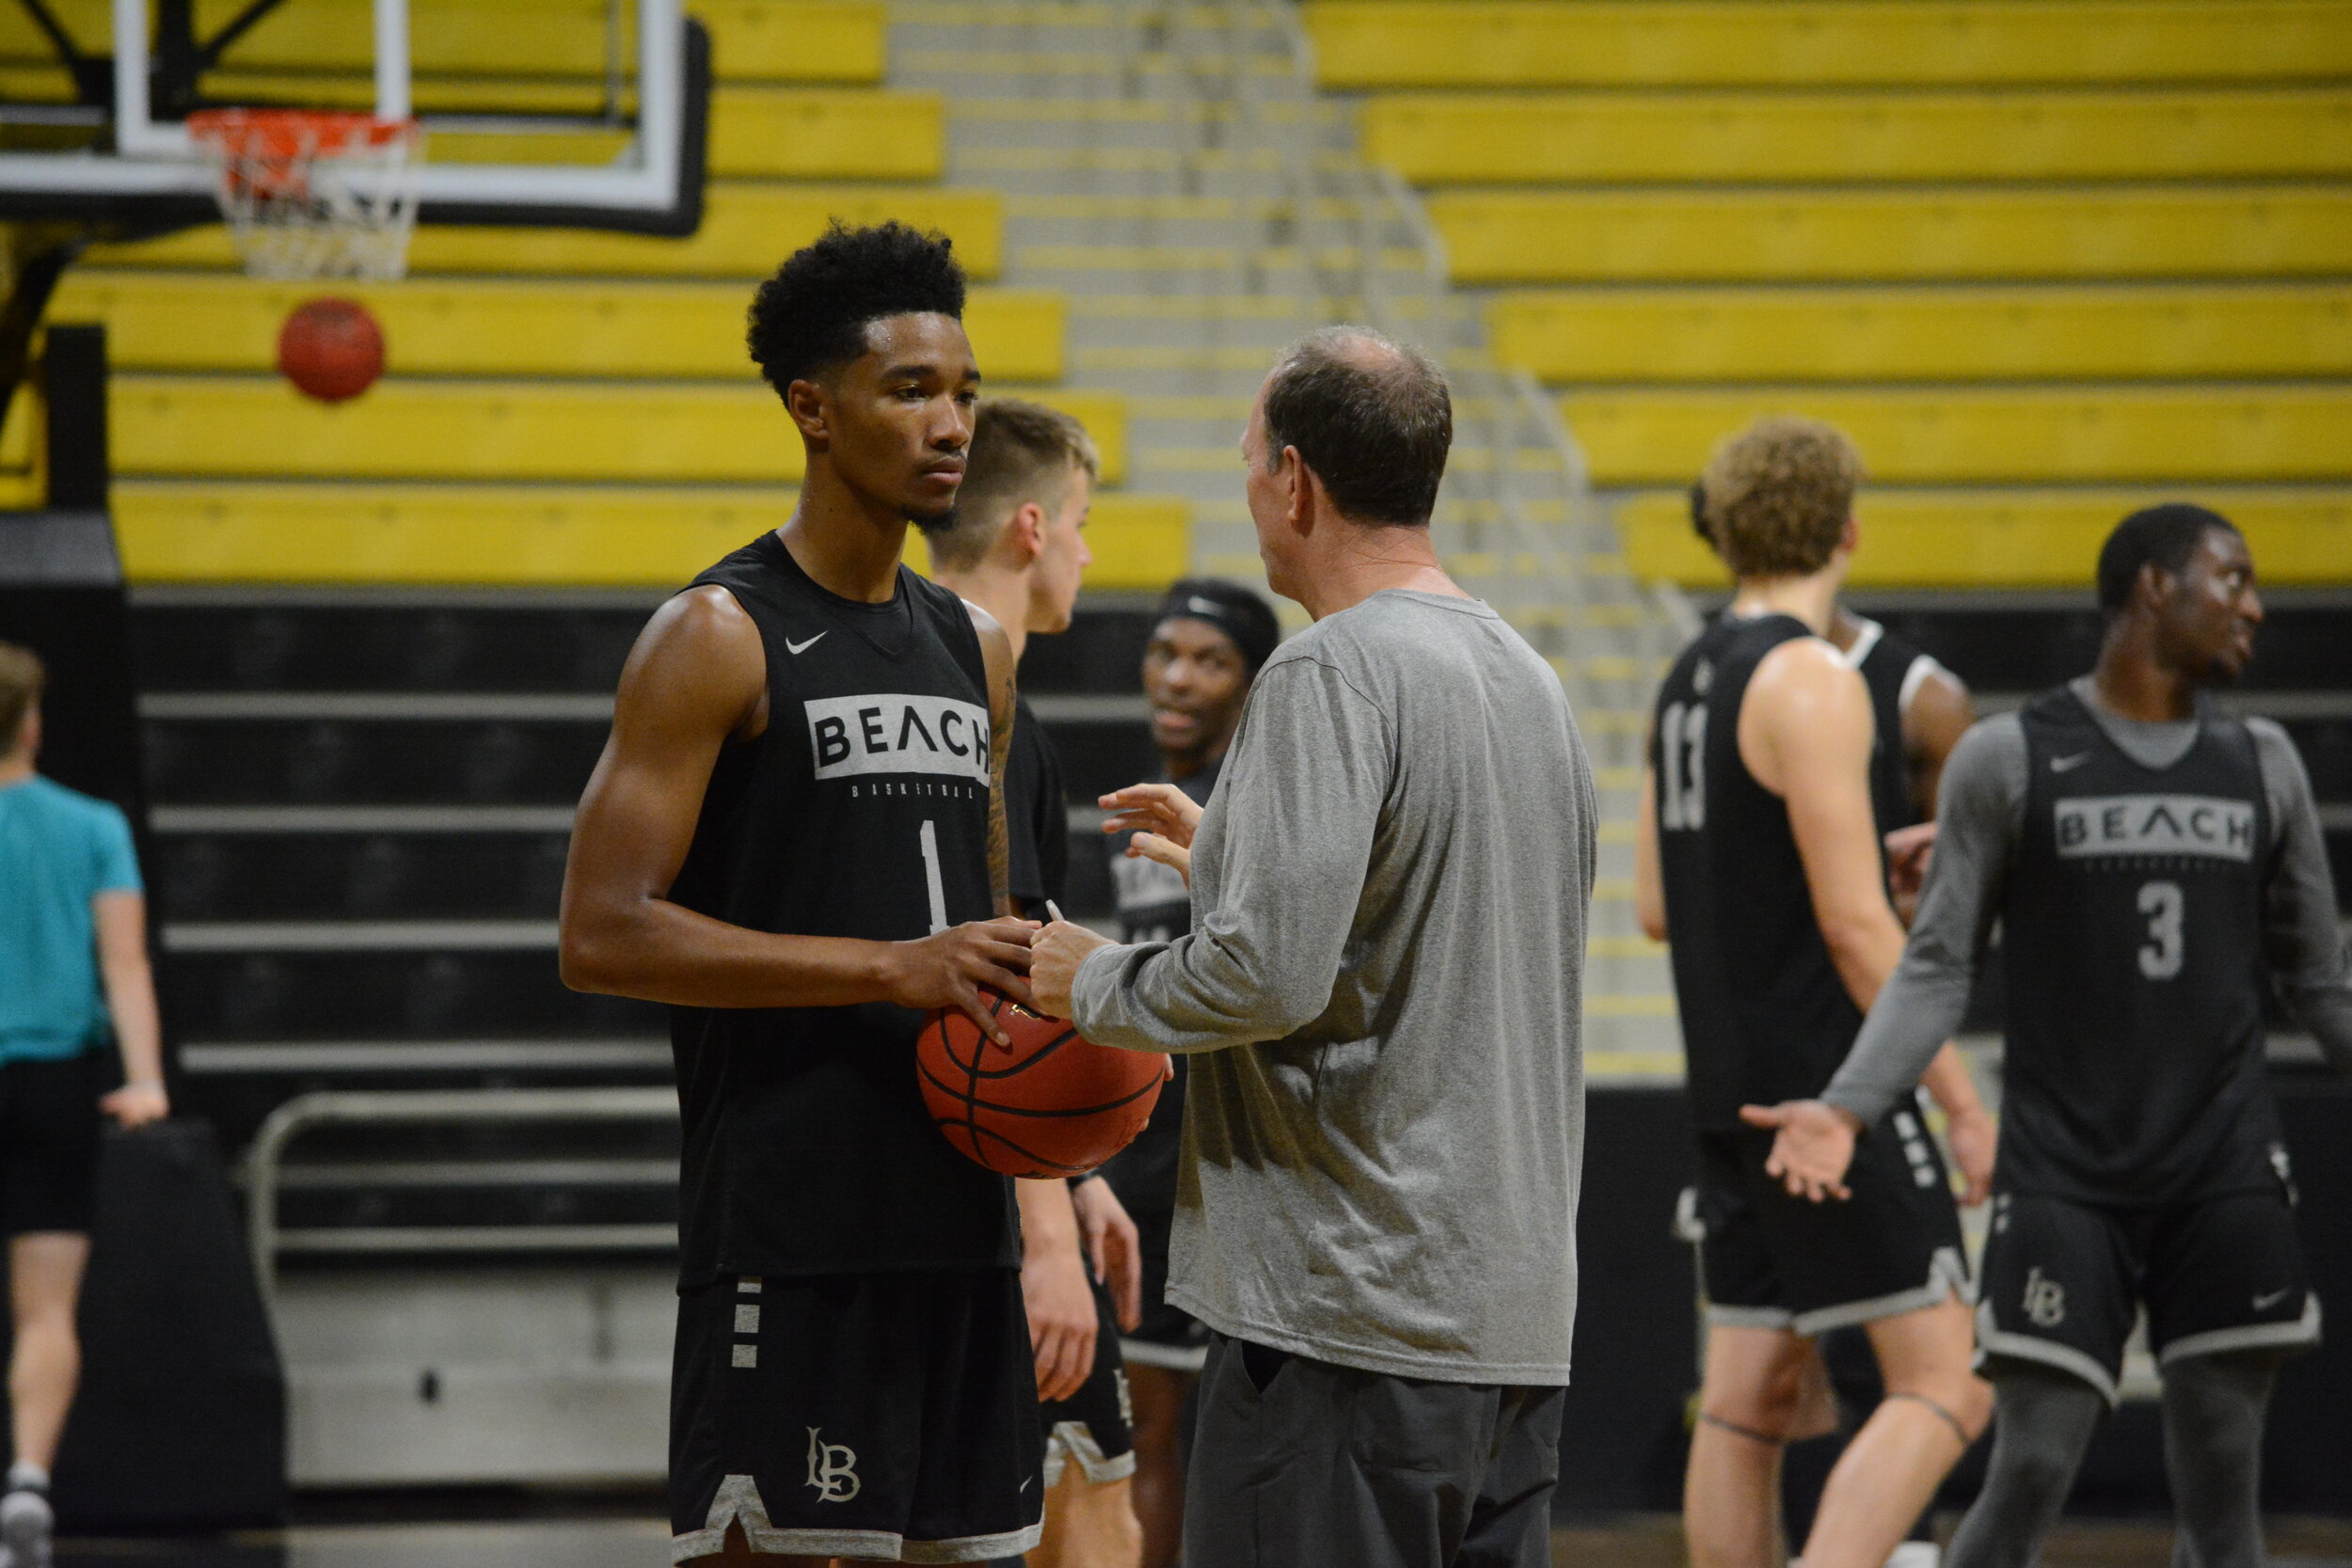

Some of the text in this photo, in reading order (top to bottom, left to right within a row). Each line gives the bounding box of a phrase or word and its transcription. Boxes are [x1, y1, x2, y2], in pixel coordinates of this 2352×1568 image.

[815, 705, 990, 774] BEACH
[851, 783, 974, 800] BASKETBAL
[2060, 804, 2249, 847] BEACH
[919, 820, 951, 936] 1
[2137, 879, 2184, 981] 3
[803, 1425, 862, 1504] LB
